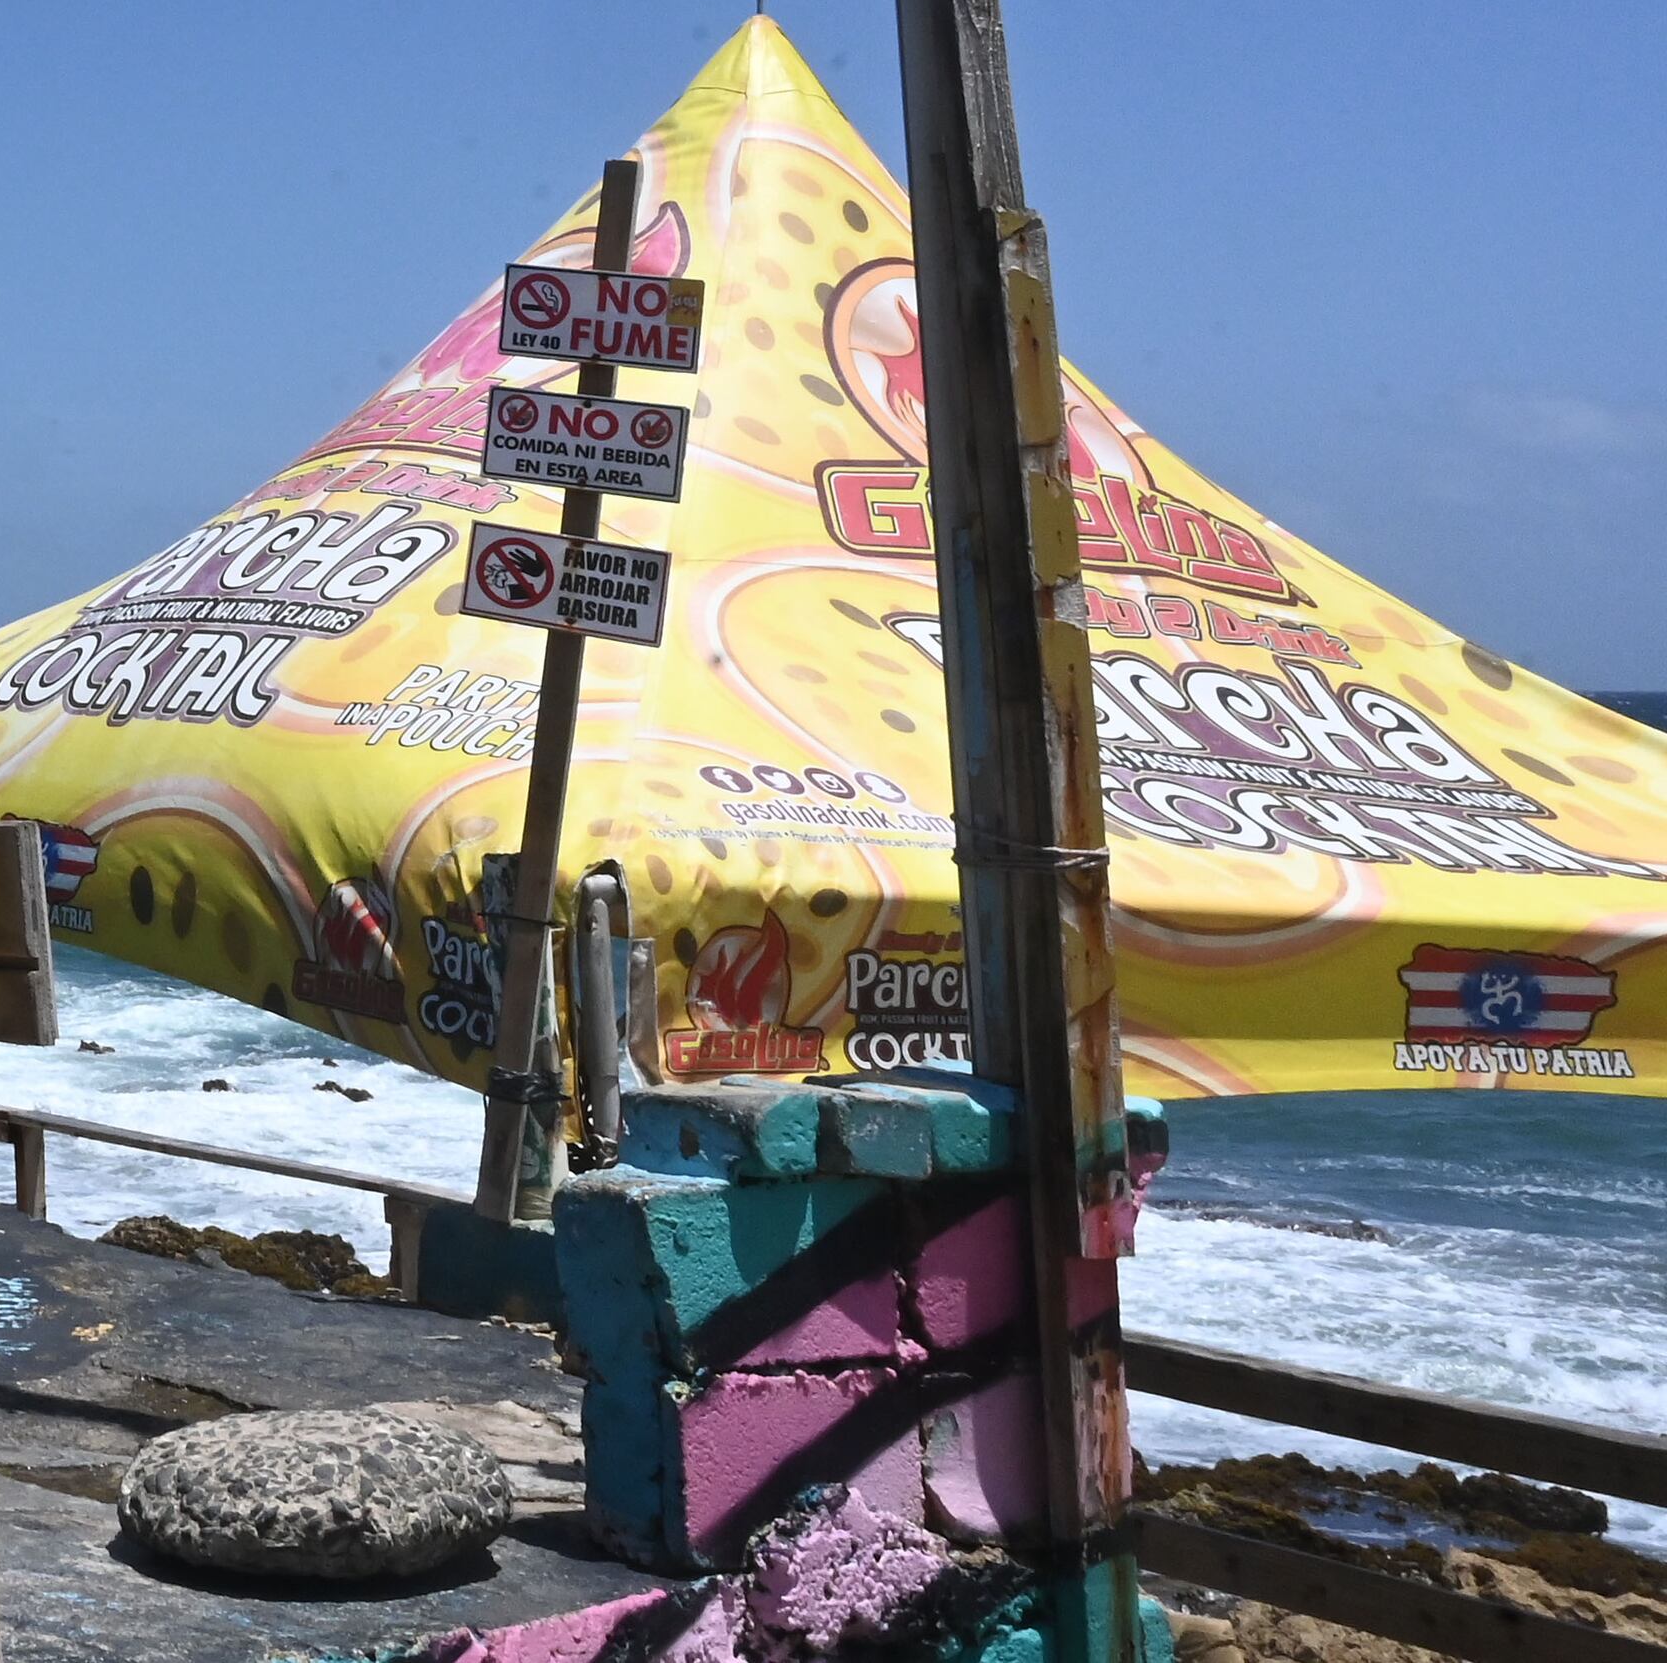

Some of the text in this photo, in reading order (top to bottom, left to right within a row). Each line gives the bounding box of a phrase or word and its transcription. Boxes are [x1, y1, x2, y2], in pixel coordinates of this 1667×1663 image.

[597, 279, 667, 317] NO
[512, 332, 560, 350] LEY 40
[569, 317, 689, 361] FUME
[548, 404, 619, 441] NO
[492, 434, 671, 468] COMIDA NI BEBIDA
[515, 458, 643, 486] EN ESTA AREA
[563, 547, 660, 582] FAVOR NO
[560, 572, 651, 605] ARROJAR
[156, 599, 204, 619] FRUIT
[195, 600, 214, 619] &
[208, 600, 280, 623] NATURAL
[275, 605, 358, 631] FLAVORS
[556, 596, 638, 629] BASURA
[1203, 600, 1360, 668] Drink
[334, 702, 370, 726] IN
[1123, 748, 1235, 779] PASSION
[1227, 762, 1302, 787] FRUIT
[1299, 772, 1323, 788] &
[1320, 774, 1435, 802] NATURAL
[1425, 786, 1539, 813] FLAVORS
[721, 800, 956, 834] gasolinadrink.com
[49, 904, 92, 932] ATRIA
[849, 952, 969, 1009] Parc
[847, 1030, 971, 1070] COCKT
[1491, 1046, 1529, 1074] TU
[1532, 1049, 1634, 1077] PATRIA
